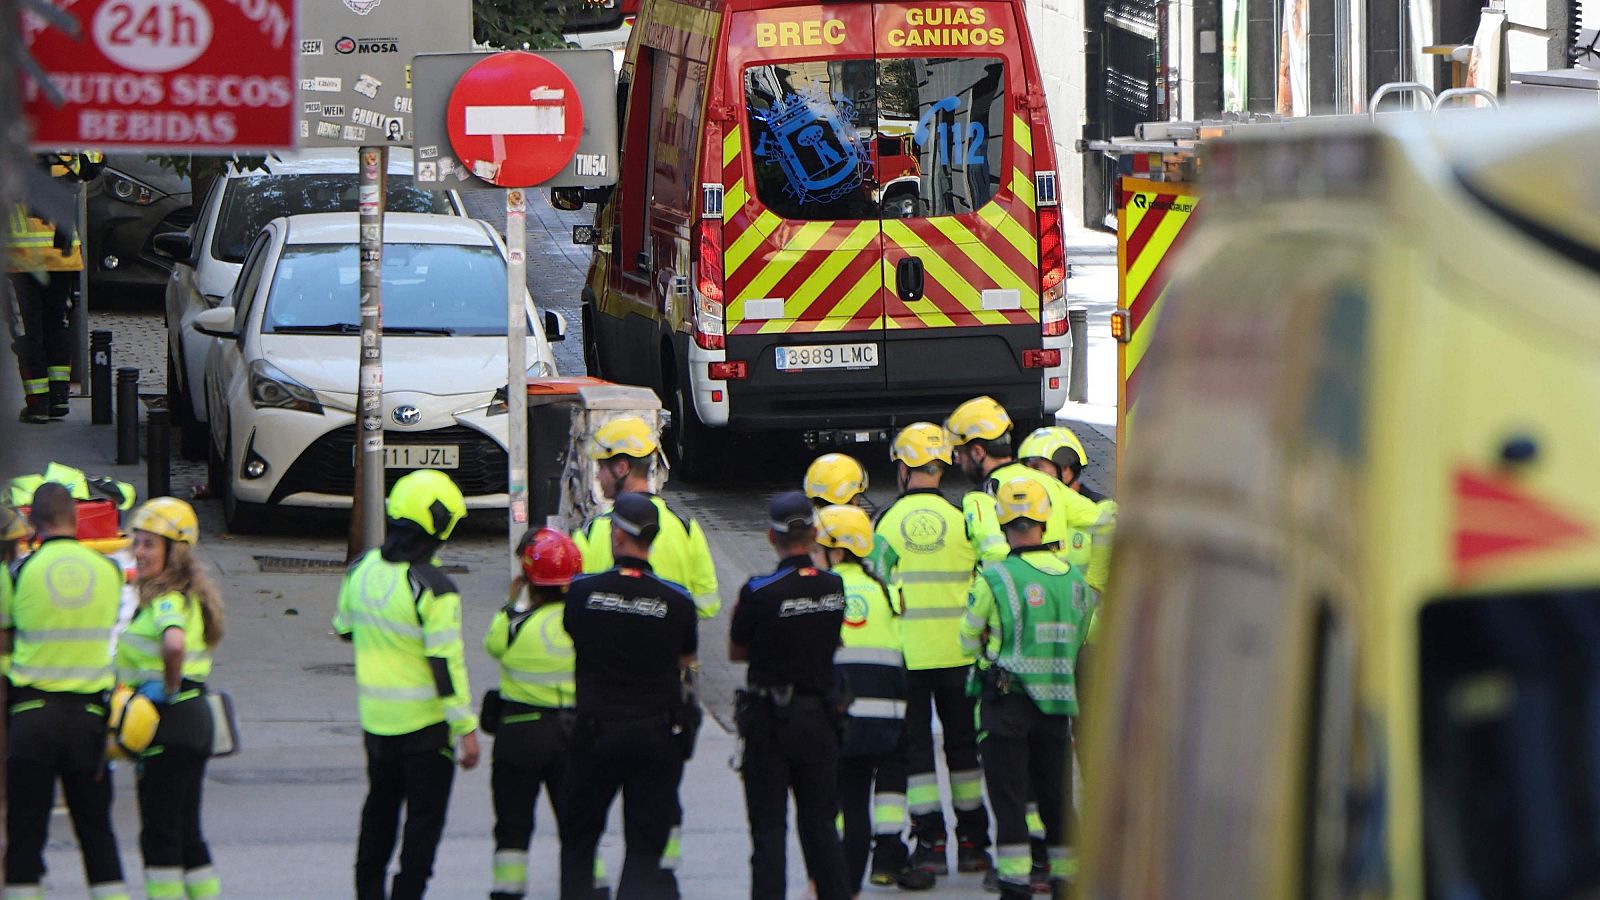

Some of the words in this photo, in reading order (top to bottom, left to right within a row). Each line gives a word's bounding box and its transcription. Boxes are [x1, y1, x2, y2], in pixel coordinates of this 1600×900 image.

[108, 3, 196, 46] 24h
[906, 7, 985, 25] GUIAS
[756, 19, 846, 48] BREC
[887, 28, 1005, 47] CANINOS
[358, 43, 398, 54] MOSA
[170, 75, 291, 108] SECOS
[78, 109, 238, 144] BEBIDAS
[937, 121, 985, 165] 112
[575, 154, 607, 177] TM54
[788, 348, 834, 366] 3989
[840, 346, 873, 364] LMC
[419, 448, 453, 466] JZL
